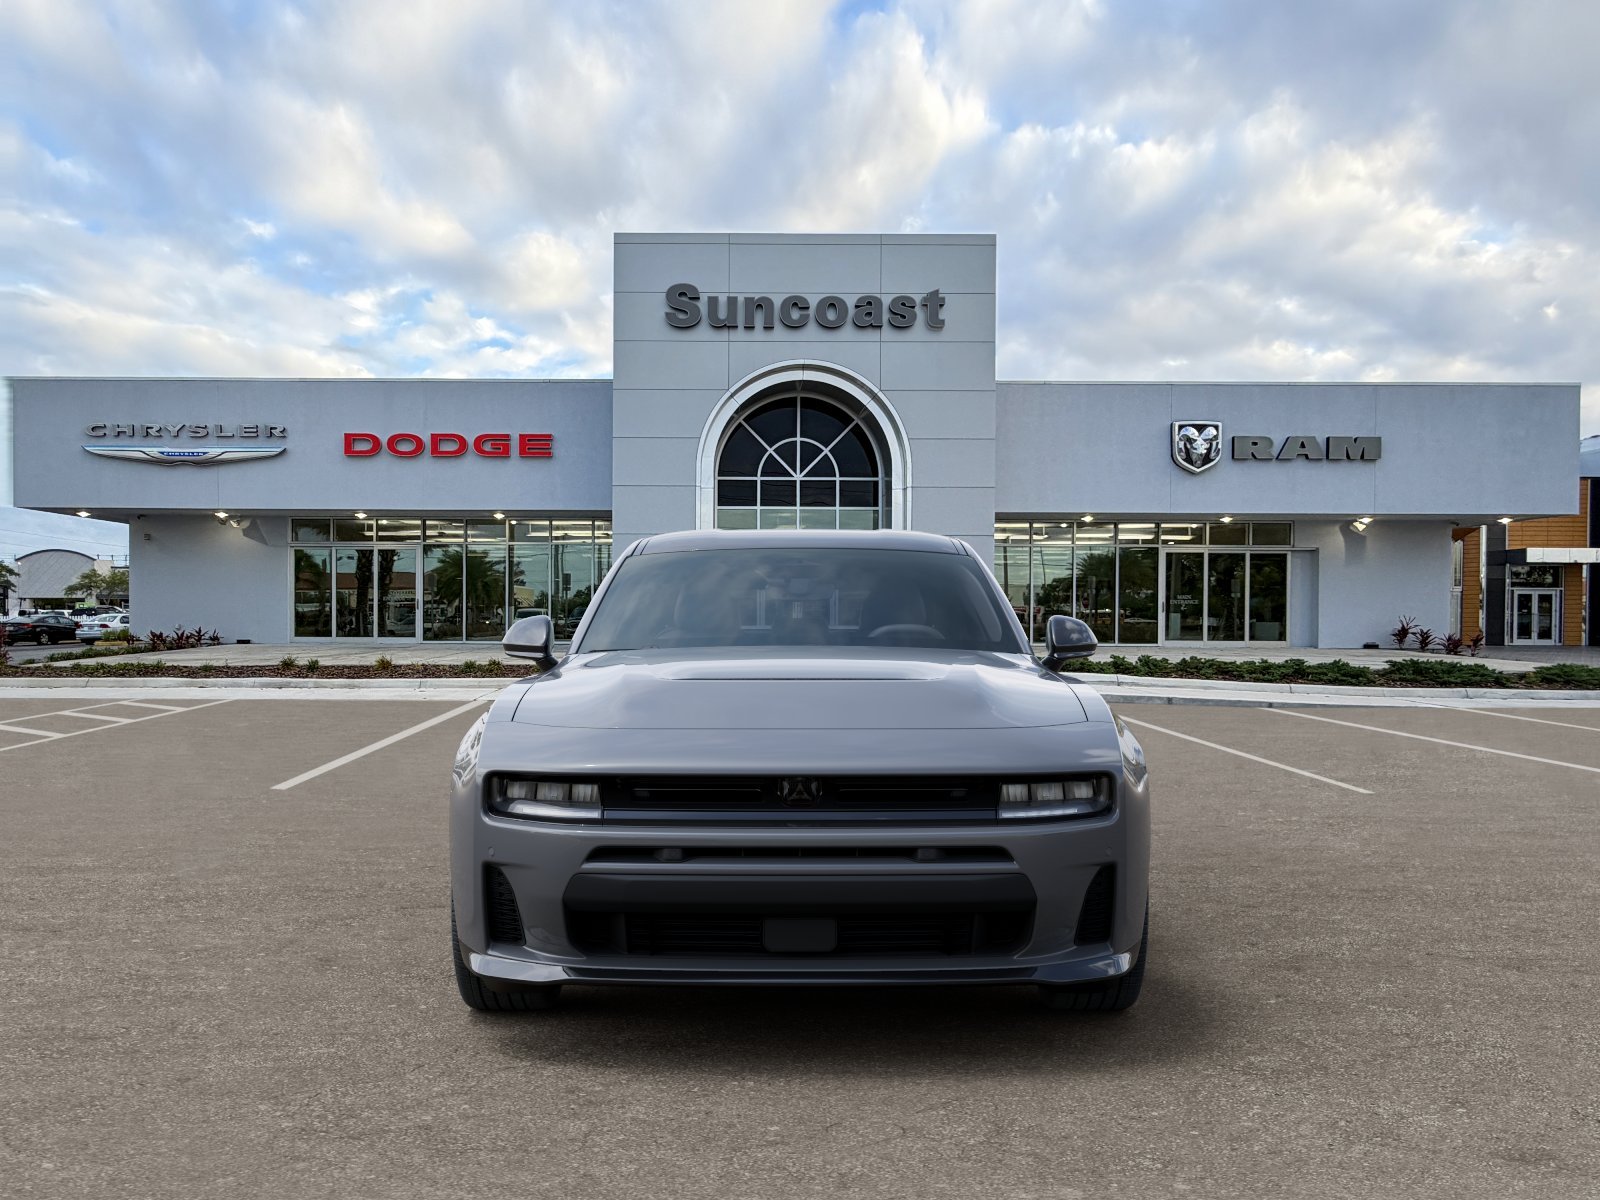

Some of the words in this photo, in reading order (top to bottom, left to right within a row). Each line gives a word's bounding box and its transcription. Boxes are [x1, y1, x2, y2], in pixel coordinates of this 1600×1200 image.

[664, 283, 946, 330] Suncoast
[85, 423, 287, 438] CHRYSLER
[343, 432, 554, 458] DODGE
[1232, 435, 1382, 460] RAM
